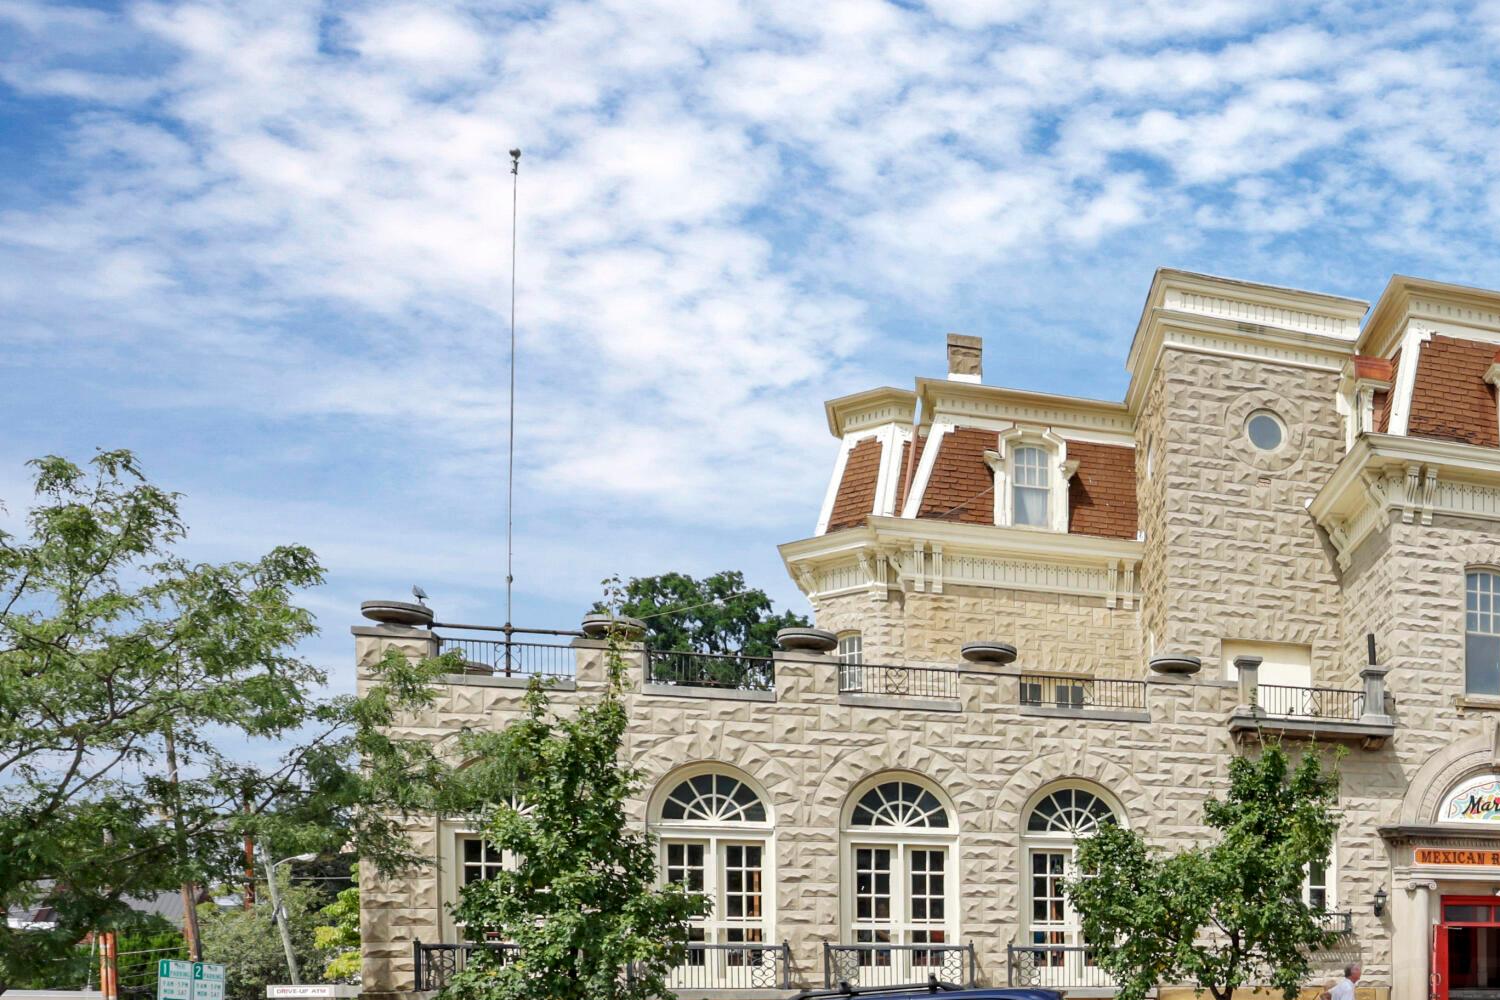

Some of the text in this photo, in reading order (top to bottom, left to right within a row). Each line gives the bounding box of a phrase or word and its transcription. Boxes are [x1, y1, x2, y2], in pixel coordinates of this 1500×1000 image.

[1421, 851, 1485, 864] MEXICAN
[163, 963, 167, 975] 1
[195, 966, 202, 978] 2
